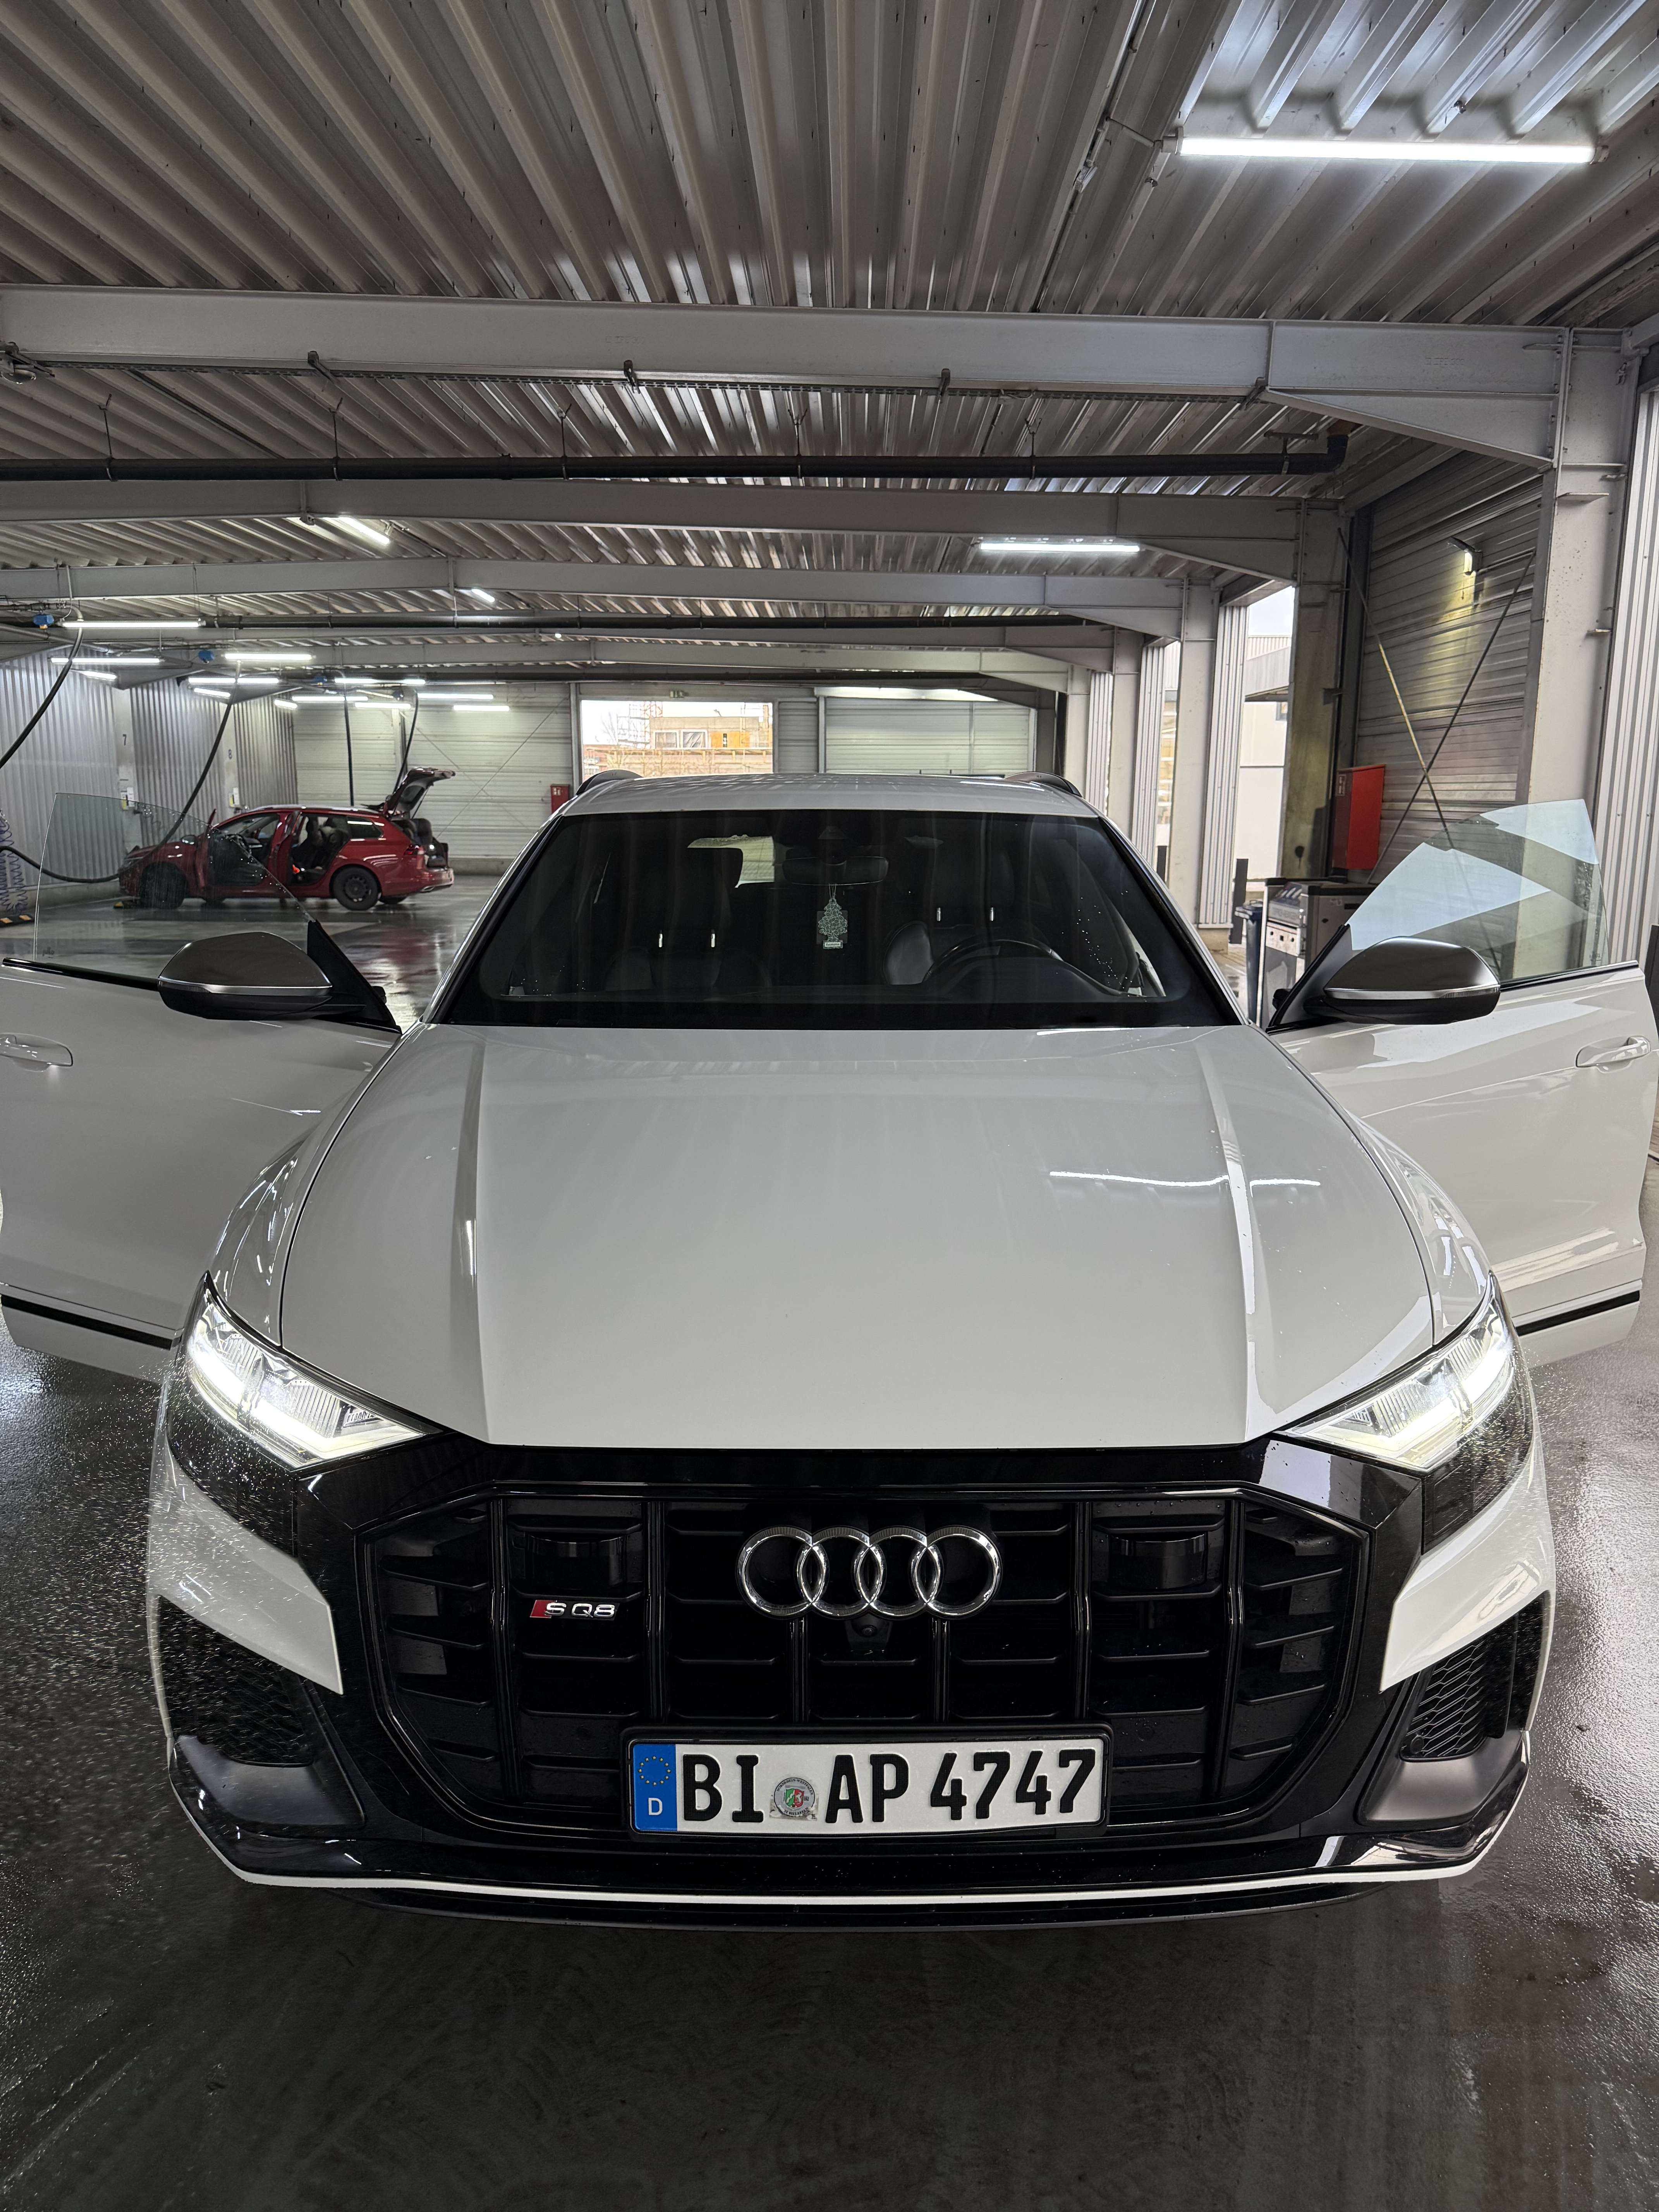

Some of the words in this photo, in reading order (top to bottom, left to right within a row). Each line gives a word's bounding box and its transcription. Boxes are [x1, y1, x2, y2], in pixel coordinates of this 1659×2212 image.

[122, 734, 127, 746] 7
[228, 749, 232, 759] 8
[683, 1754, 764, 1823] BI
[825, 1753, 909, 1823] AP
[930, 1748, 1096, 1820] 4747
[648, 1798, 663, 1815] D
